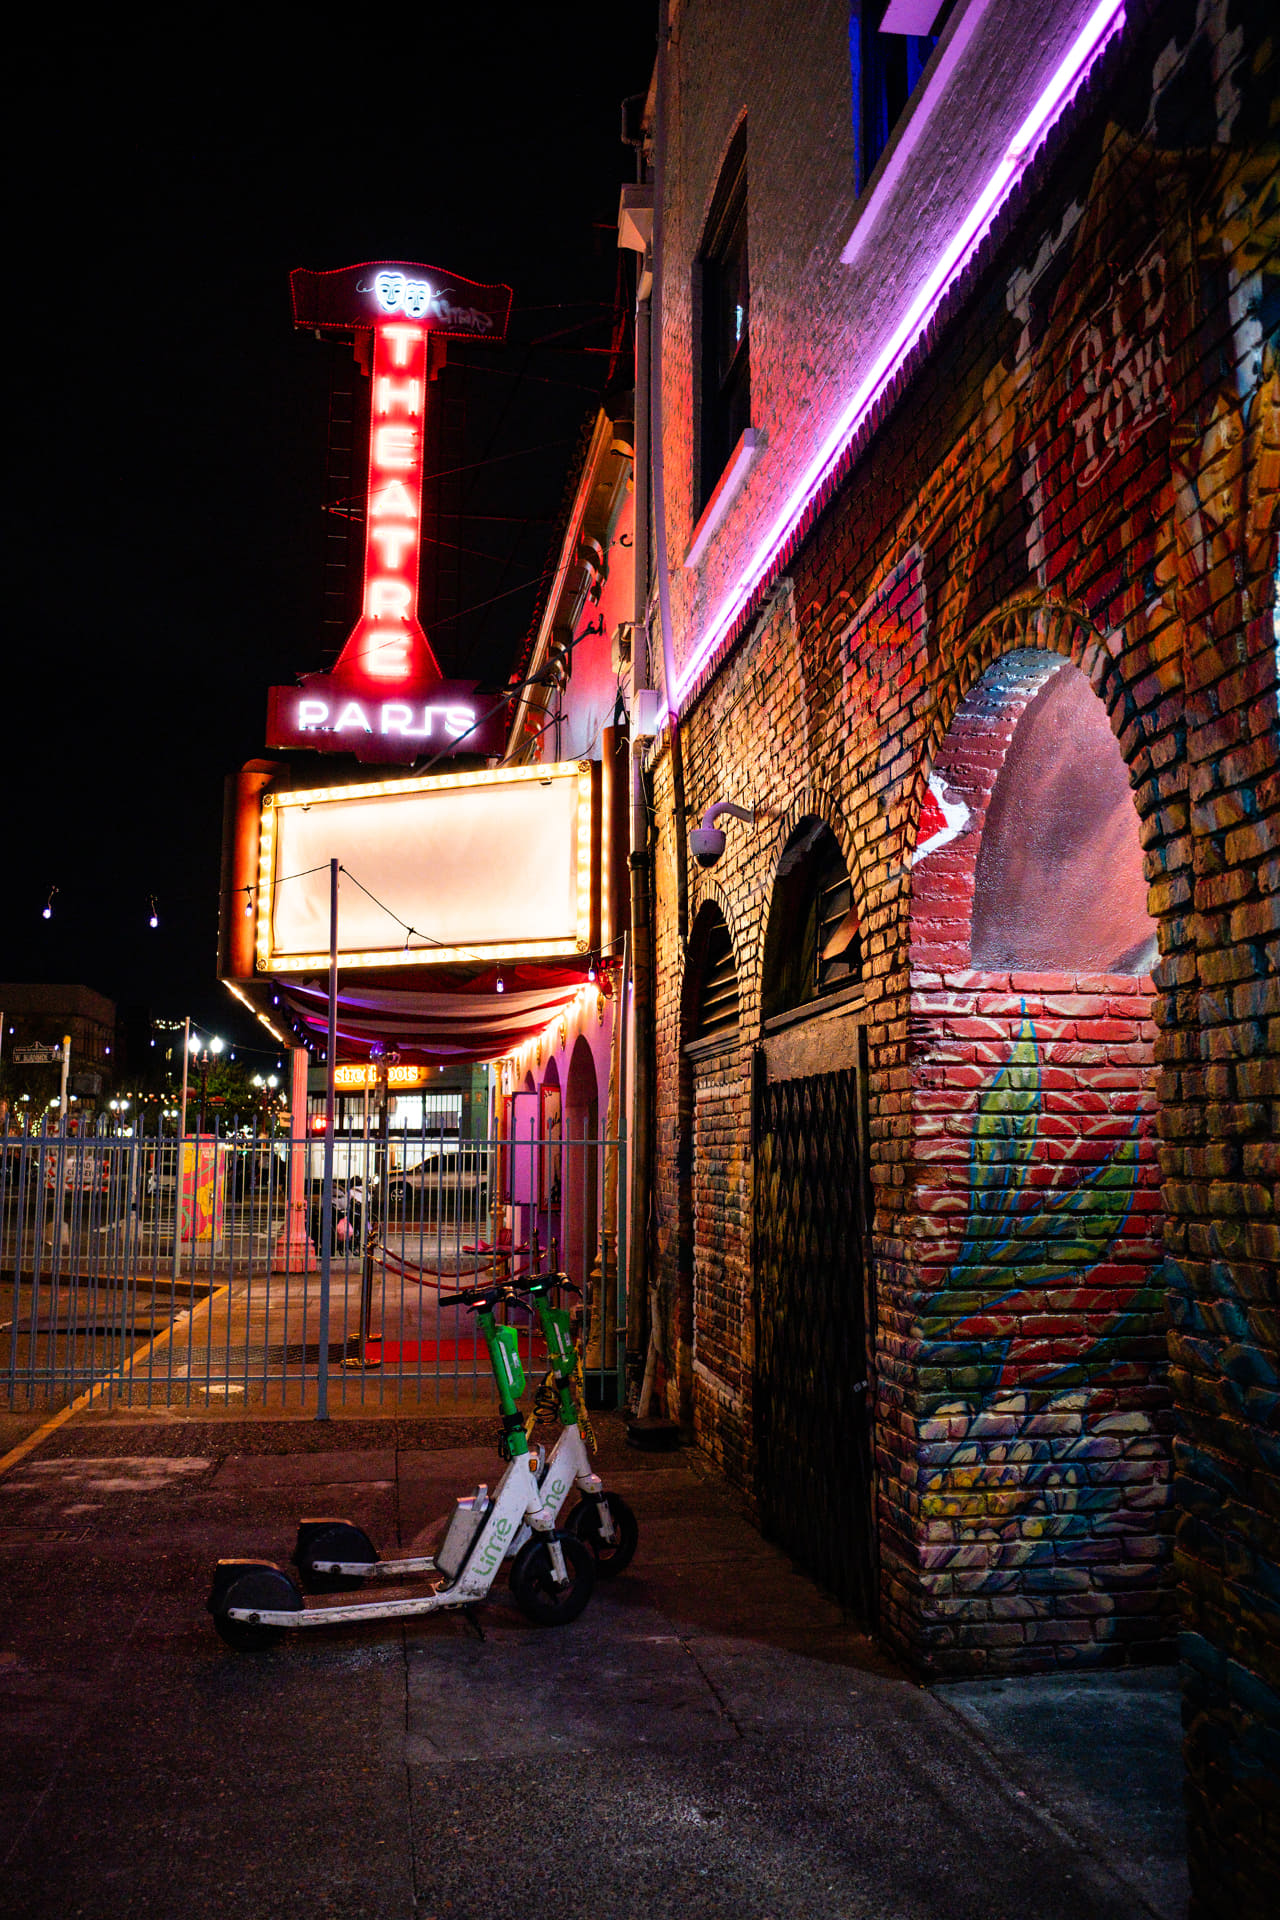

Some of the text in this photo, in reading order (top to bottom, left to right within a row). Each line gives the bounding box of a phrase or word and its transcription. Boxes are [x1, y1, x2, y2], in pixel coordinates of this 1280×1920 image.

[366, 326, 423, 678] THEATRE
[296, 699, 477, 739] PARIS
[377, 1066, 418, 1082] oots
[542, 1479, 567, 1511] me
